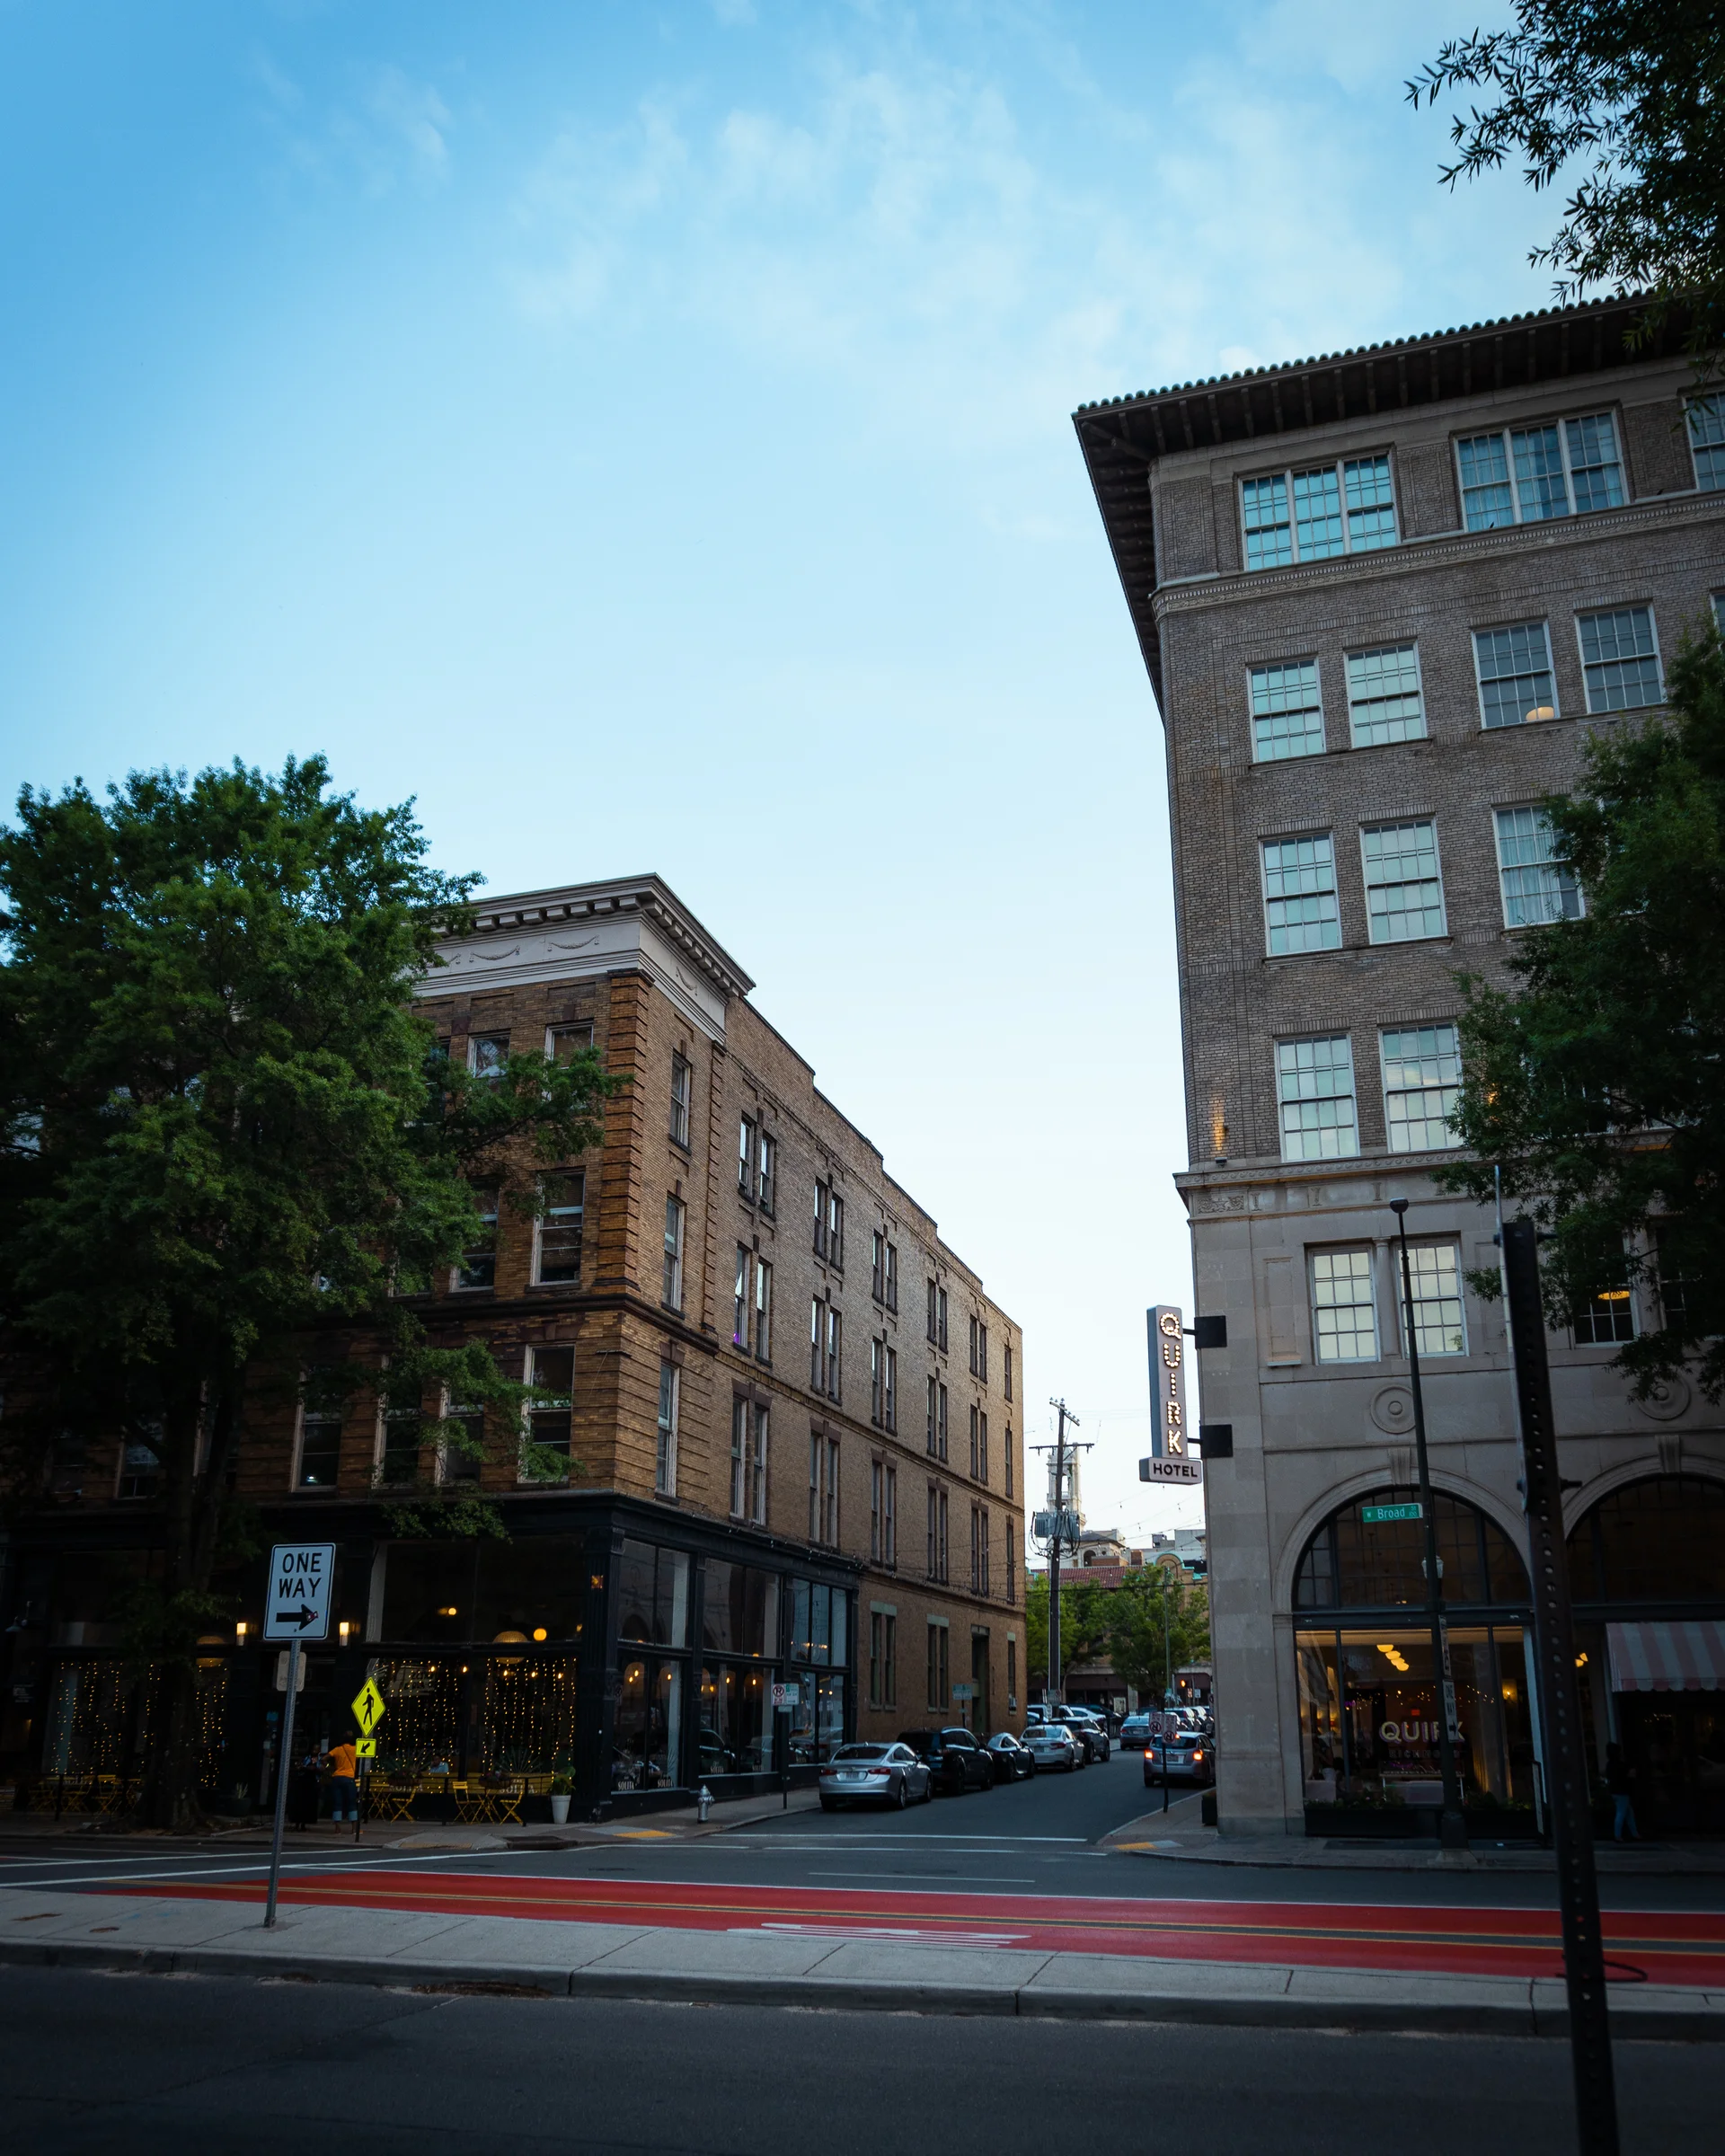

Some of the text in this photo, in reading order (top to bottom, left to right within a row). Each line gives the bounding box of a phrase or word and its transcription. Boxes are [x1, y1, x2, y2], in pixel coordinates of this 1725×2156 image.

[1159, 1312, 1182, 1454] QUIRK
[1153, 1462, 1198, 1478] HOTEL
[1377, 1507, 1405, 1519] Broad
[282, 1552, 322, 1573] ONE
[279, 1577, 322, 1598] WAY
